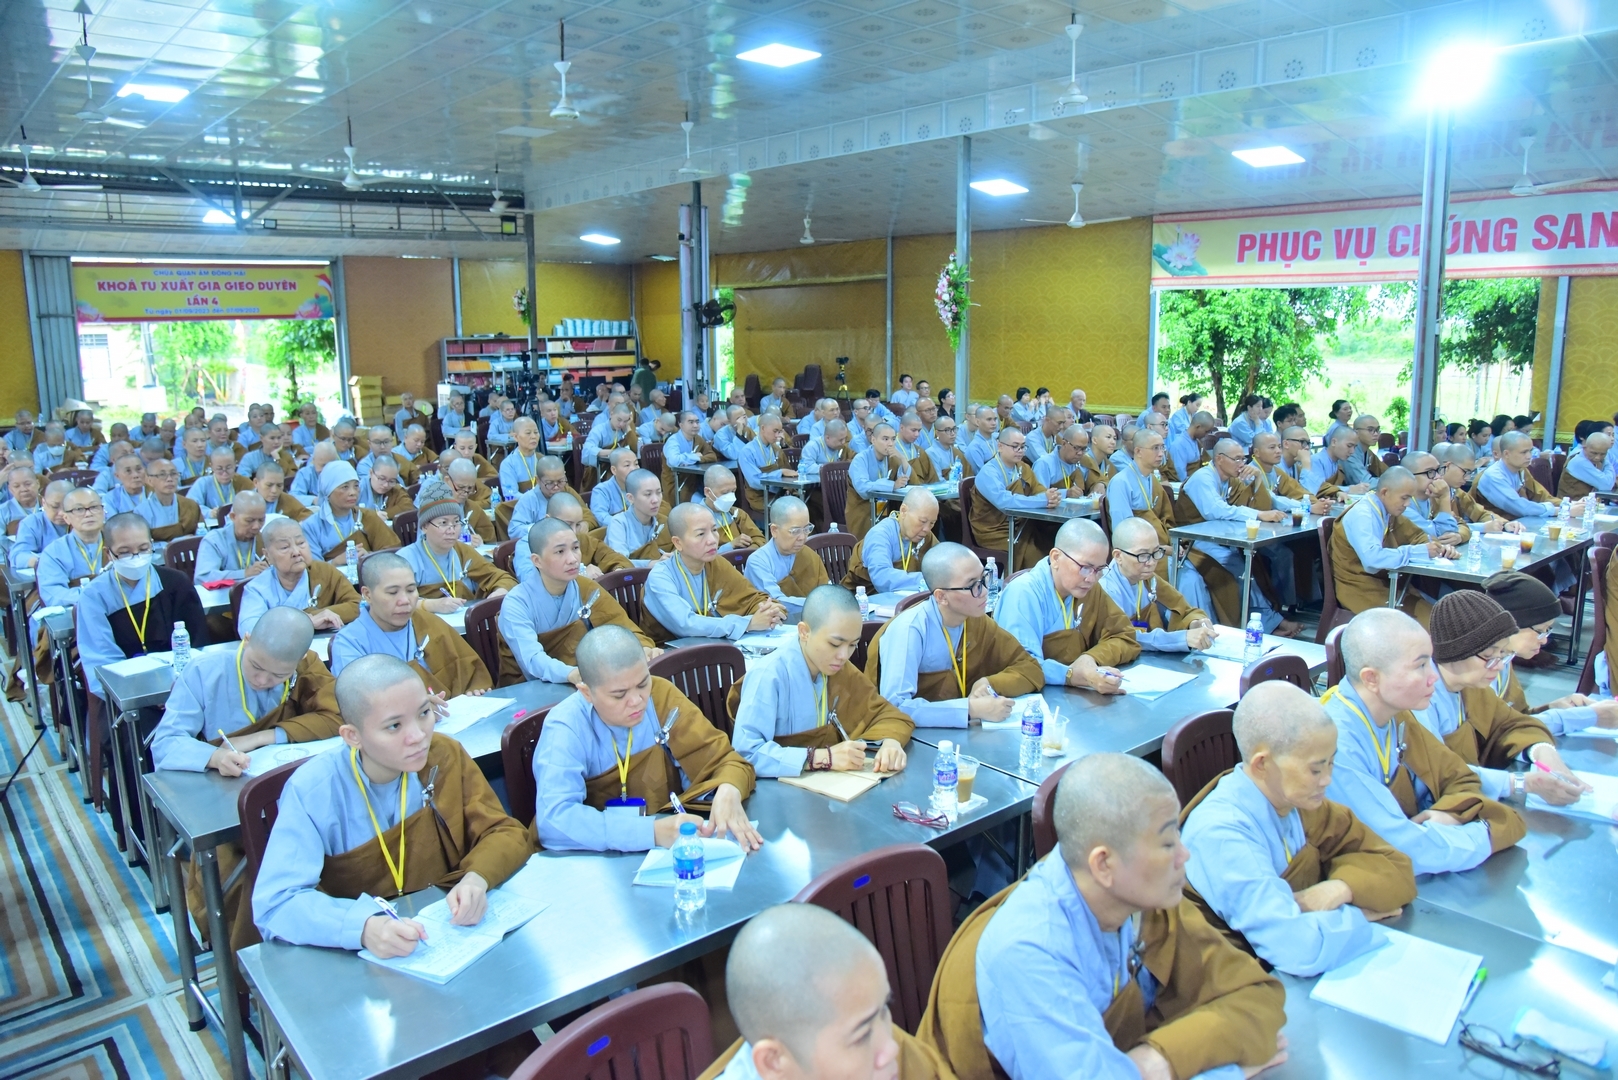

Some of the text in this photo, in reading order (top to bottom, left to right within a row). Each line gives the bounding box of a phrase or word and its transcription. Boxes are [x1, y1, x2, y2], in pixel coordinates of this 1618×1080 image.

[1237, 230, 1322, 268] PHỤC
[1334, 227, 1377, 266] VỤ
[141, 281, 157, 291] TU
[161, 278, 194, 291] XUẤT
[197, 281, 221, 291] GIA
[224, 281, 255, 291] GIEO
[258, 279, 297, 291] DUYÊN
[211, 297, 219, 306] 4
